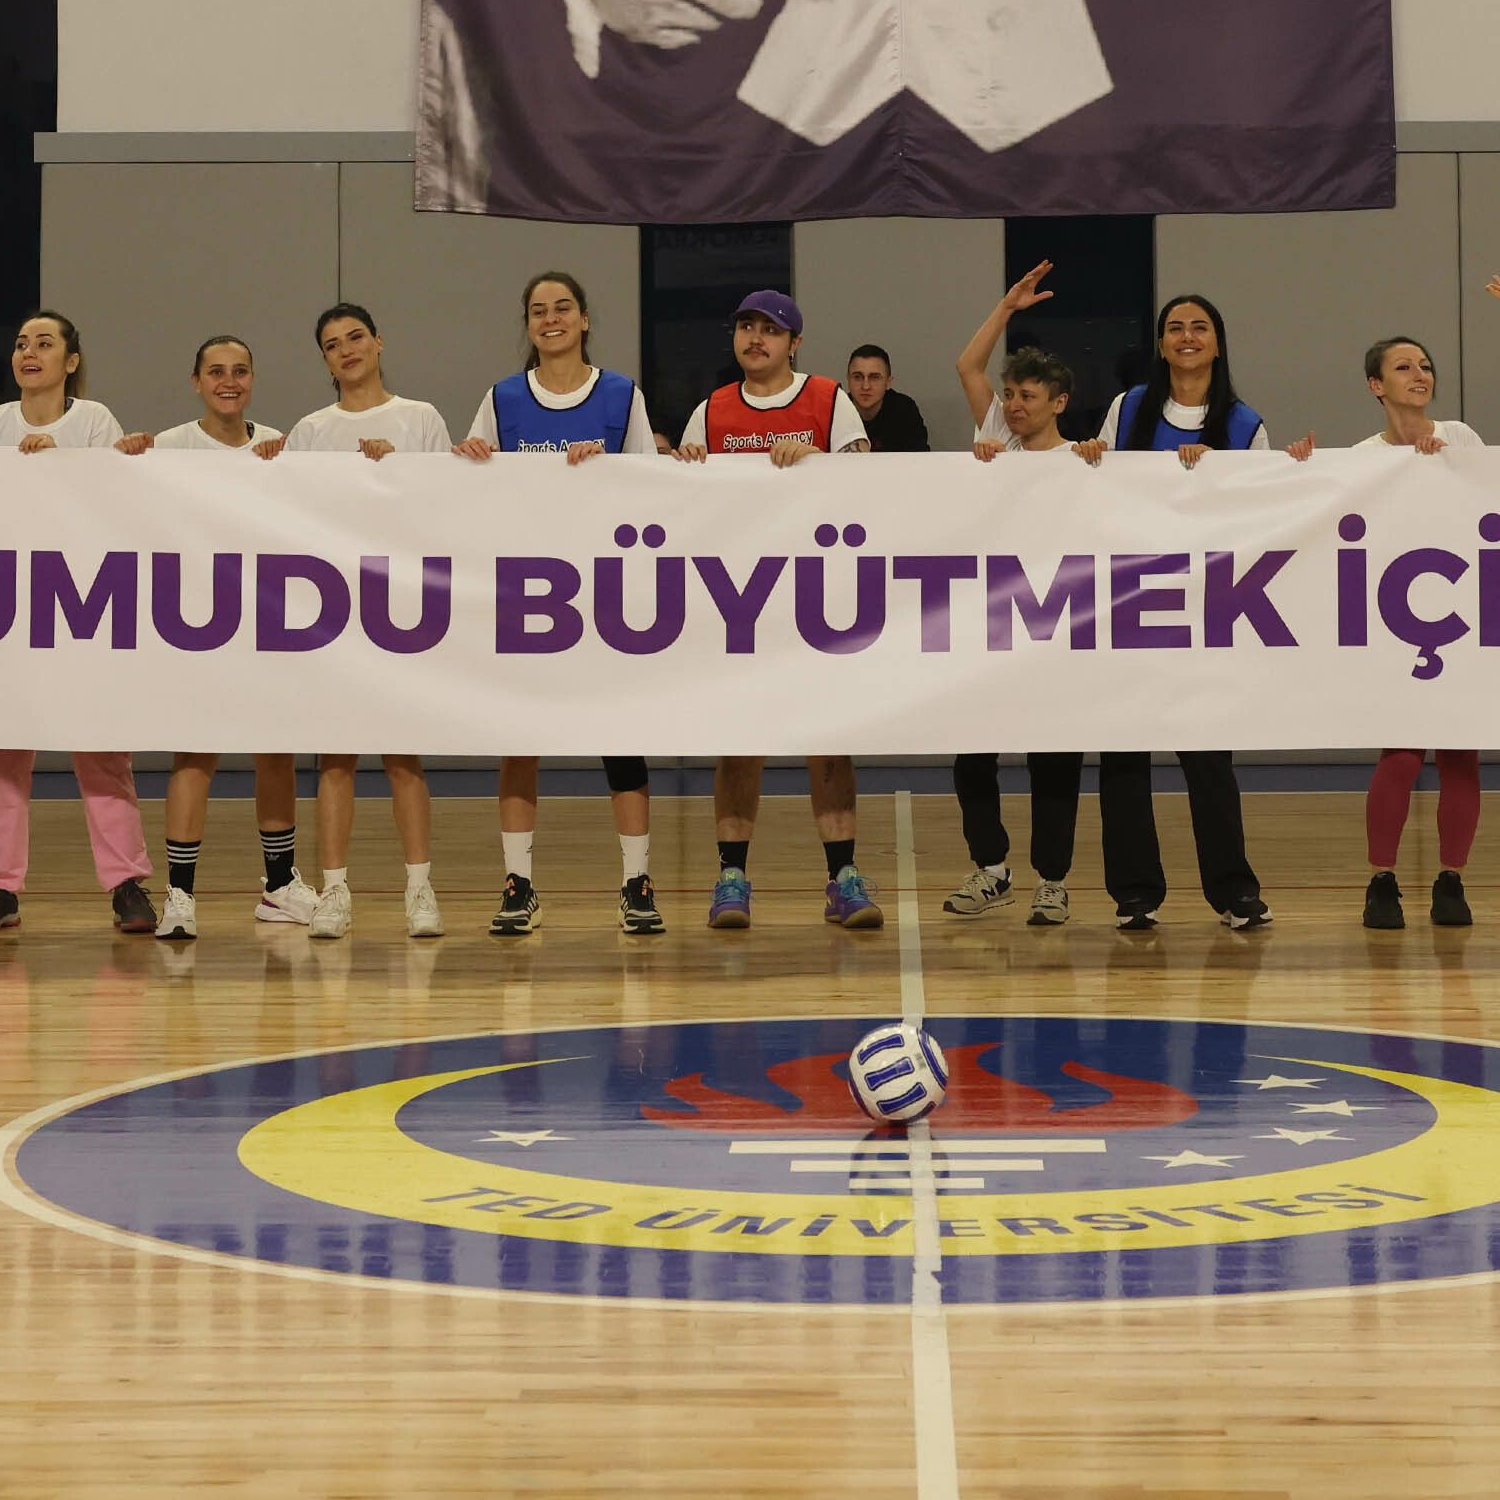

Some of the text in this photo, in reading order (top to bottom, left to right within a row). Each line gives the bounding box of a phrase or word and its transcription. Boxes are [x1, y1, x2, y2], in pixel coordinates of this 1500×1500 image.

[724, 433, 762, 452] Sports
[495, 523, 1300, 656] BÜYÜTMEK
[424, 1187, 612, 1220] TED
